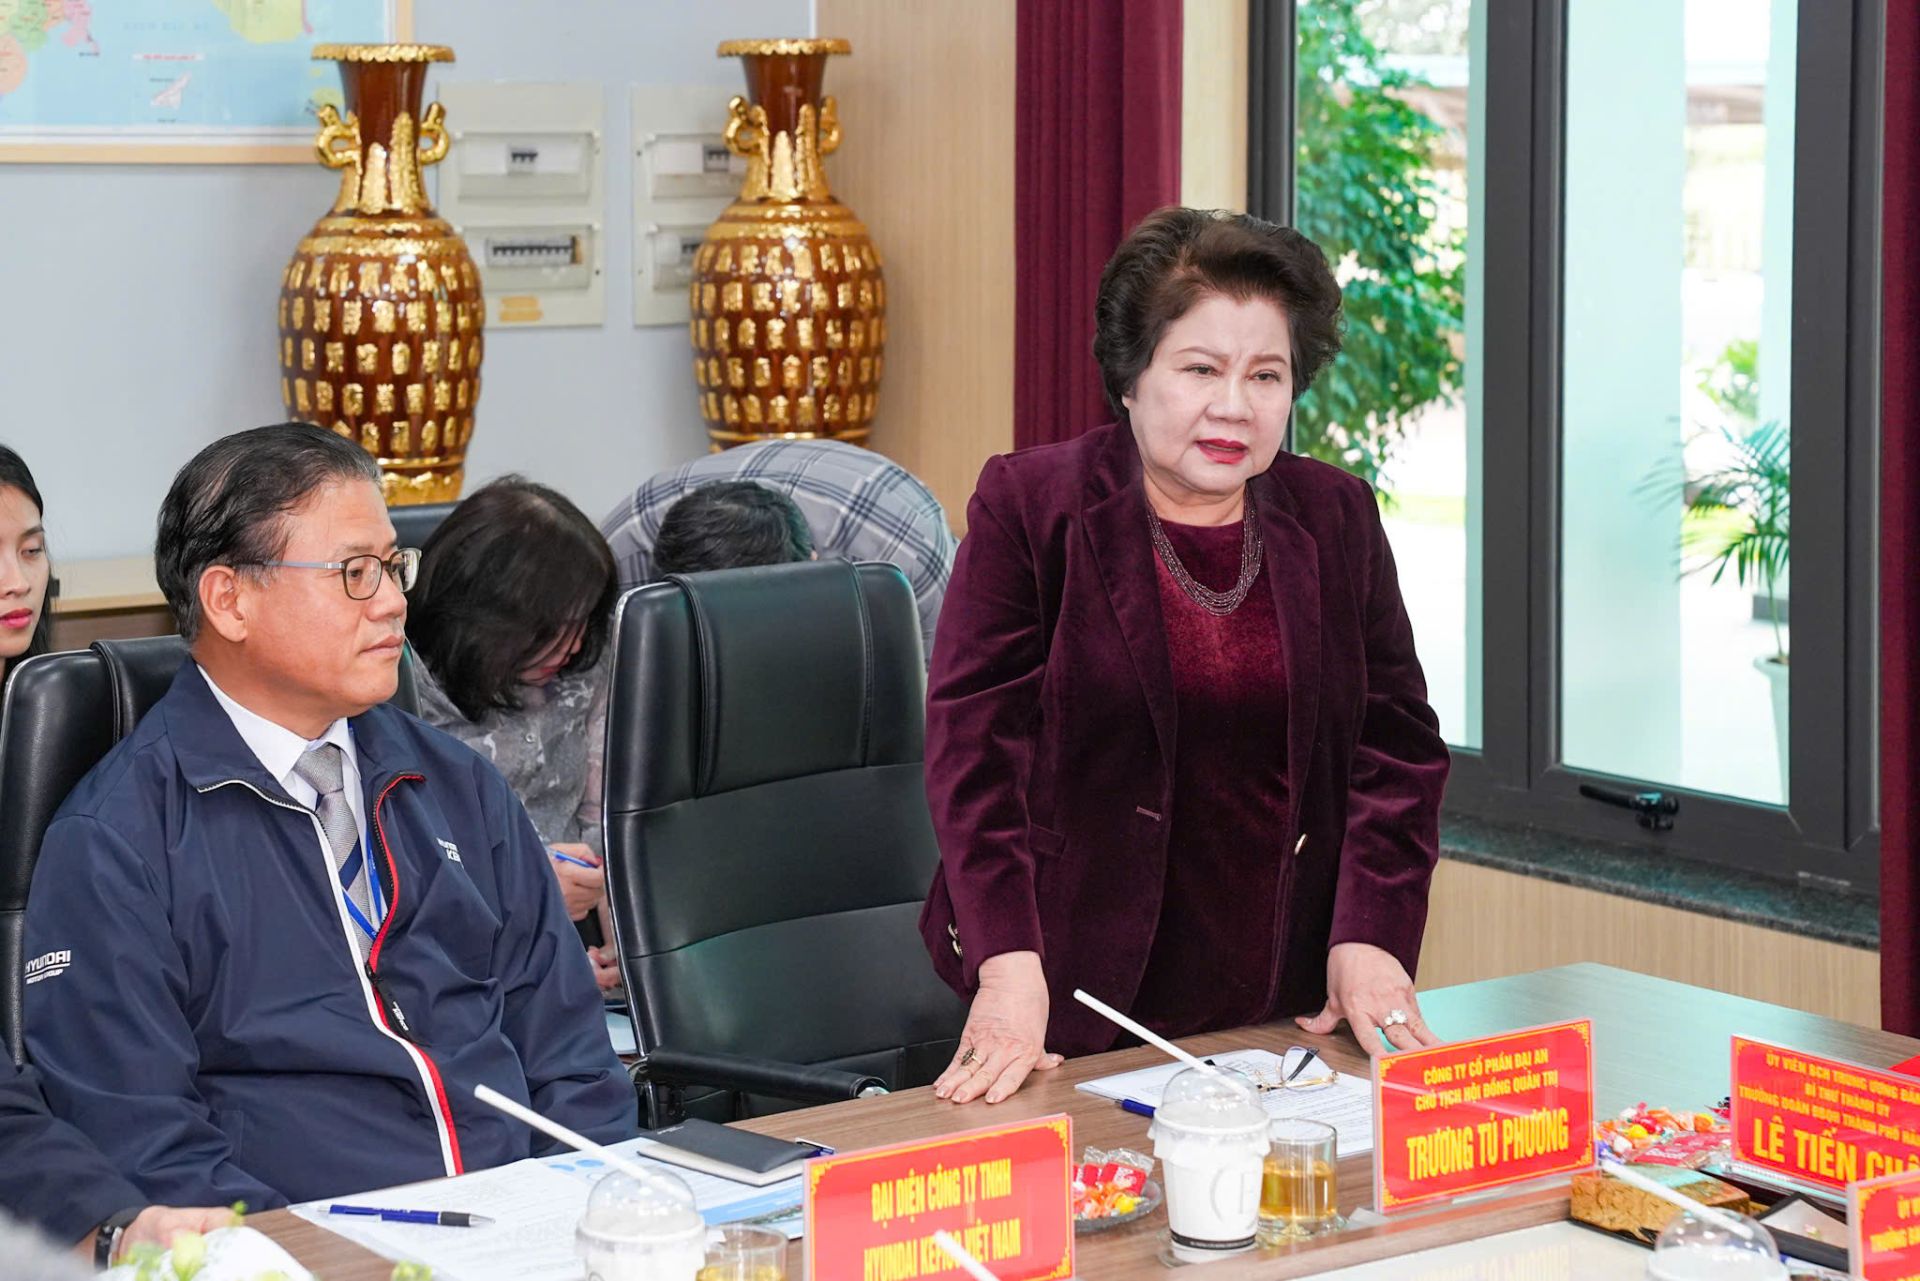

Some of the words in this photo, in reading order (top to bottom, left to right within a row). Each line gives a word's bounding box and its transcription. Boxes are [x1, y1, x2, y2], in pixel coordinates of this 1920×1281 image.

[24, 949, 71, 974] HYUNDAI
[1423, 1066, 1453, 1085] CÔNG
[1455, 1063, 1466, 1079] TY
[1534, 1048, 1549, 1064] AN
[1833, 1070, 1867, 1090] TRUNG
[1406, 1126, 1474, 1181] TRƯƠNG
[1477, 1111, 1498, 1167] TÚ
[1502, 1106, 1569, 1162] PHƯƠNG
[1753, 1115, 1785, 1163] LÊ
[1793, 1127, 1858, 1184] TIẾN
[871, 1180, 894, 1229] ĐẠI
[896, 1168, 925, 1223] DIỆN
[927, 1163, 961, 1211] CÔNG
[962, 1164, 978, 1204] TY
[979, 1157, 1012, 1201] TNHH
[864, 1238, 918, 1281] HYUNDAI
[991, 1217, 1021, 1261] NAM
